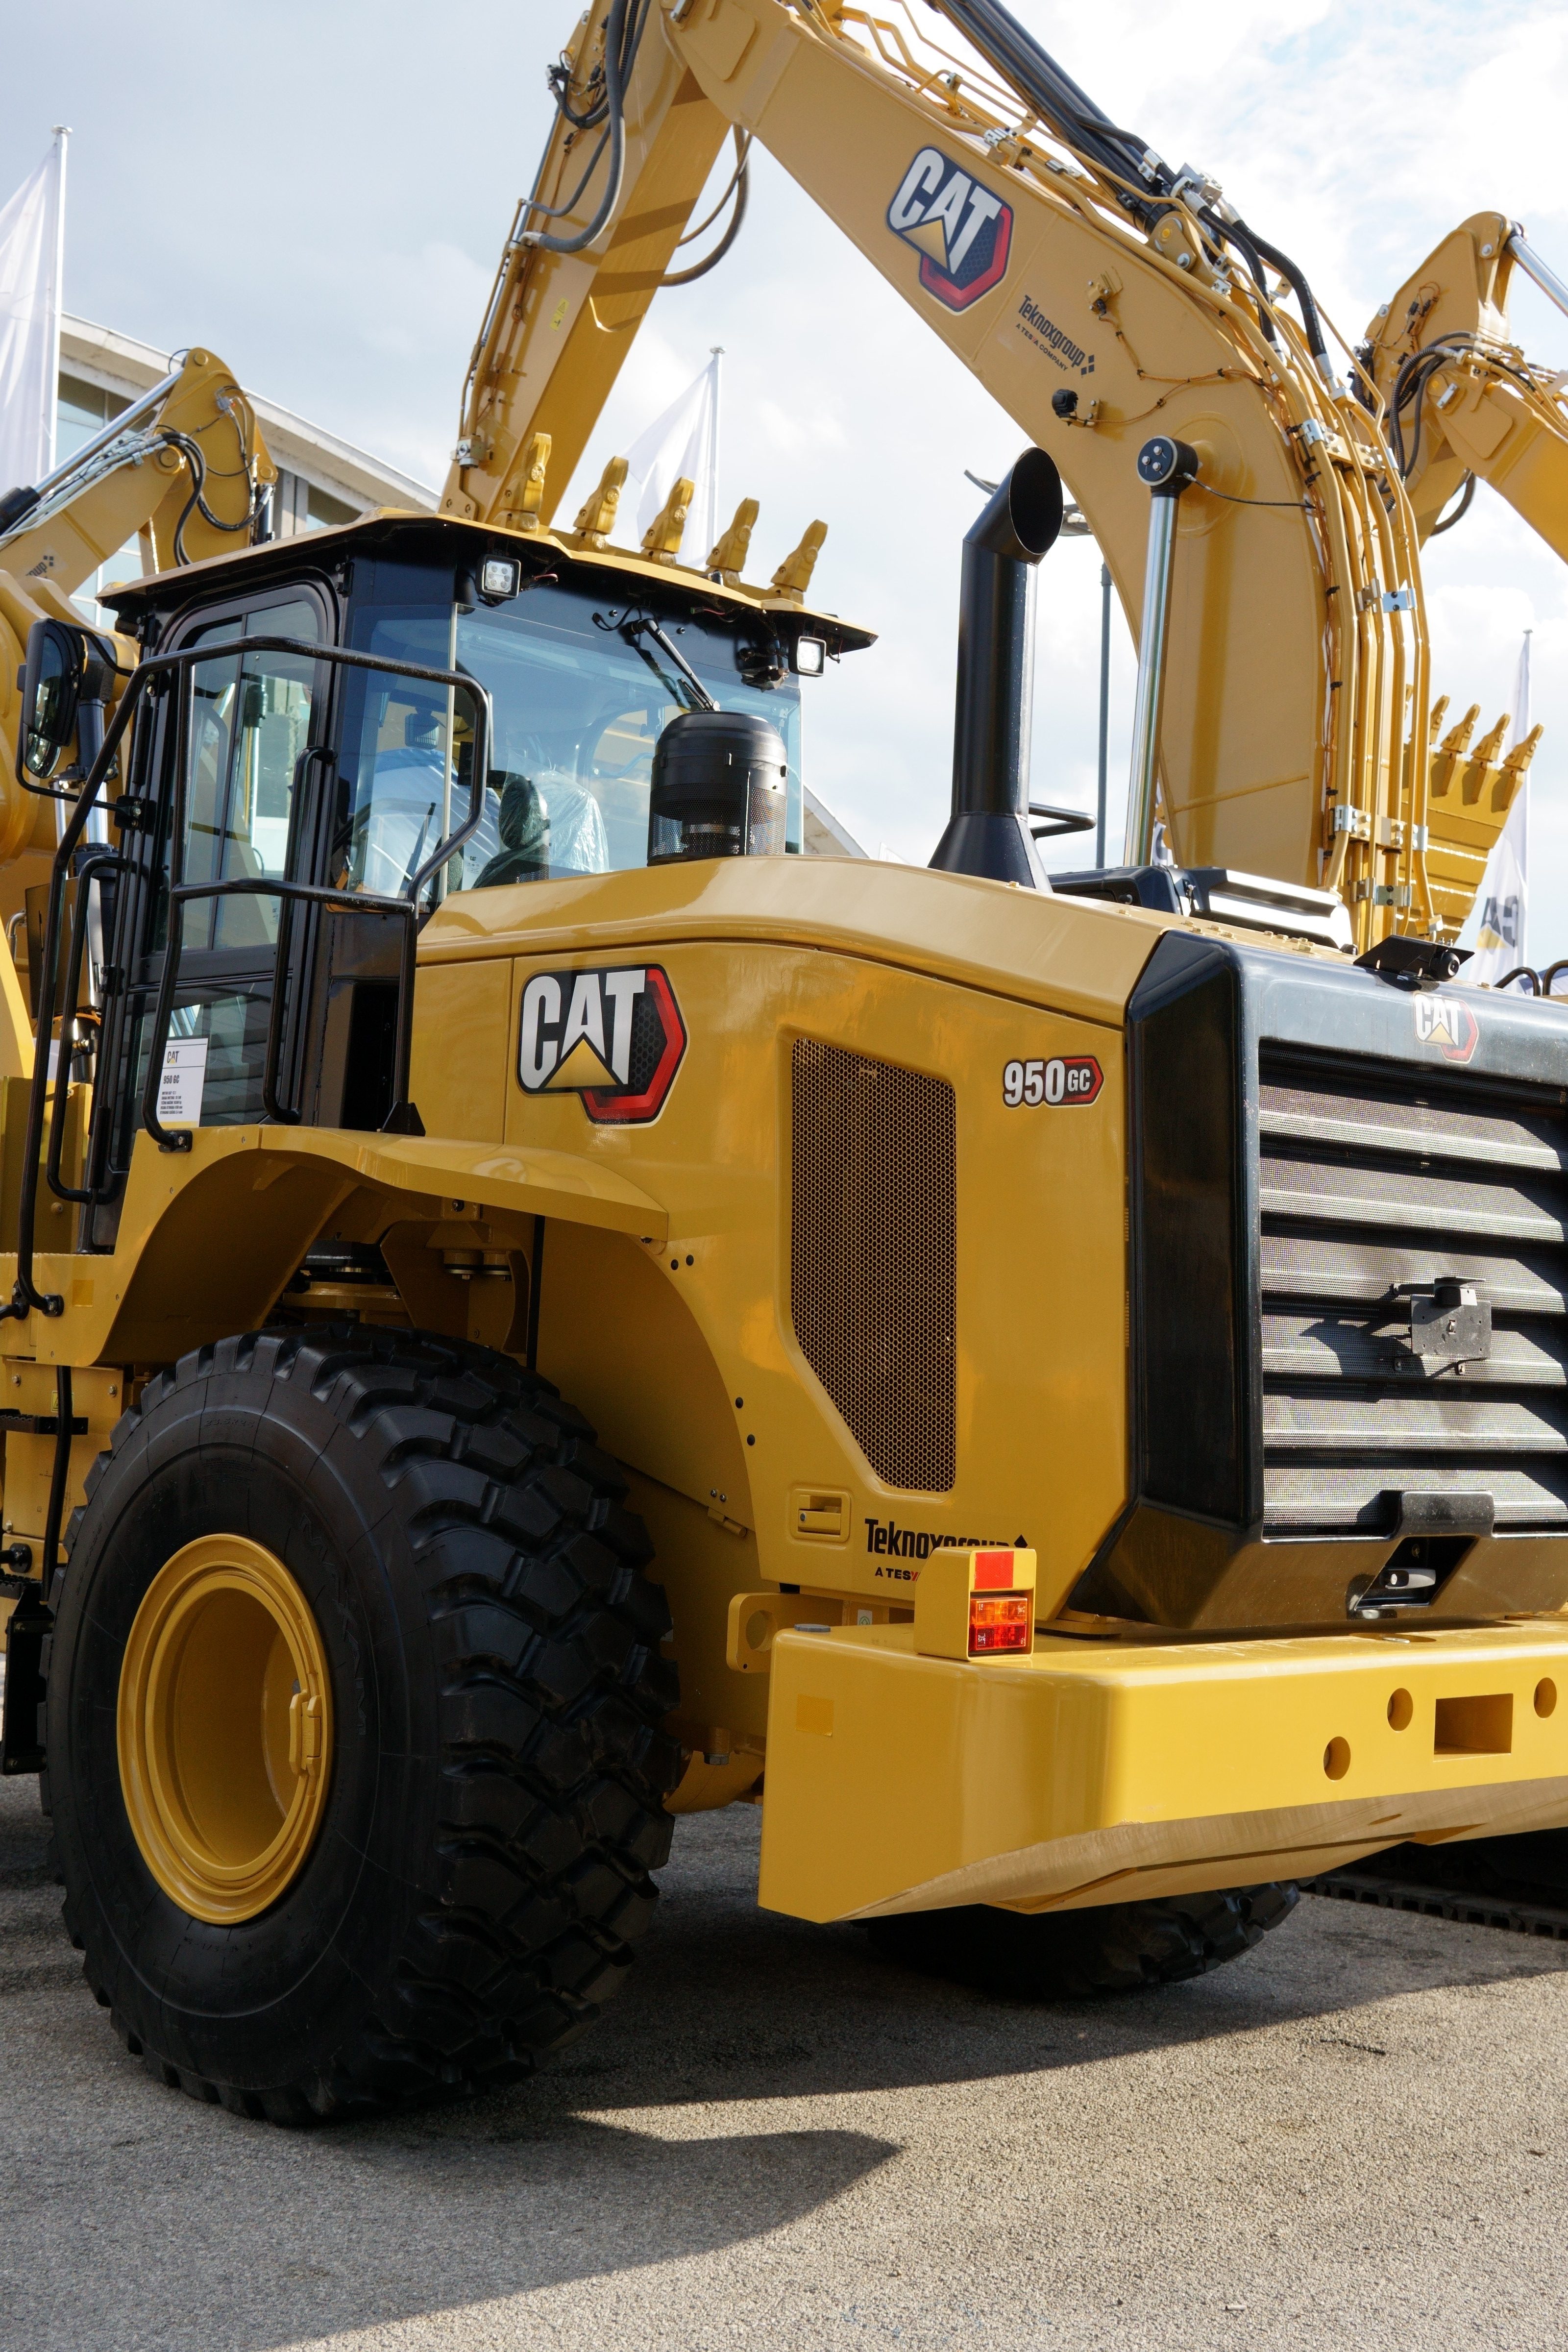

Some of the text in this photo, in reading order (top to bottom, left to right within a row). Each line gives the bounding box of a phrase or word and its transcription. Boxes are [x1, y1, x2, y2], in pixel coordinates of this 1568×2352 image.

[890, 148, 1002, 274] CAT
[1018, 294, 1085, 368] Teknoxgroup
[1039, 344, 1068, 371] COMPANY
[520, 970, 645, 1088] CAT
[1415, 994, 1461, 1045] CAT
[167, 1051, 179, 1063] CAT
[163, 1075, 180, 1084] 950 GC
[1004, 1060, 1090, 1104] 950 GC
[875, 1566, 883, 1577] A
